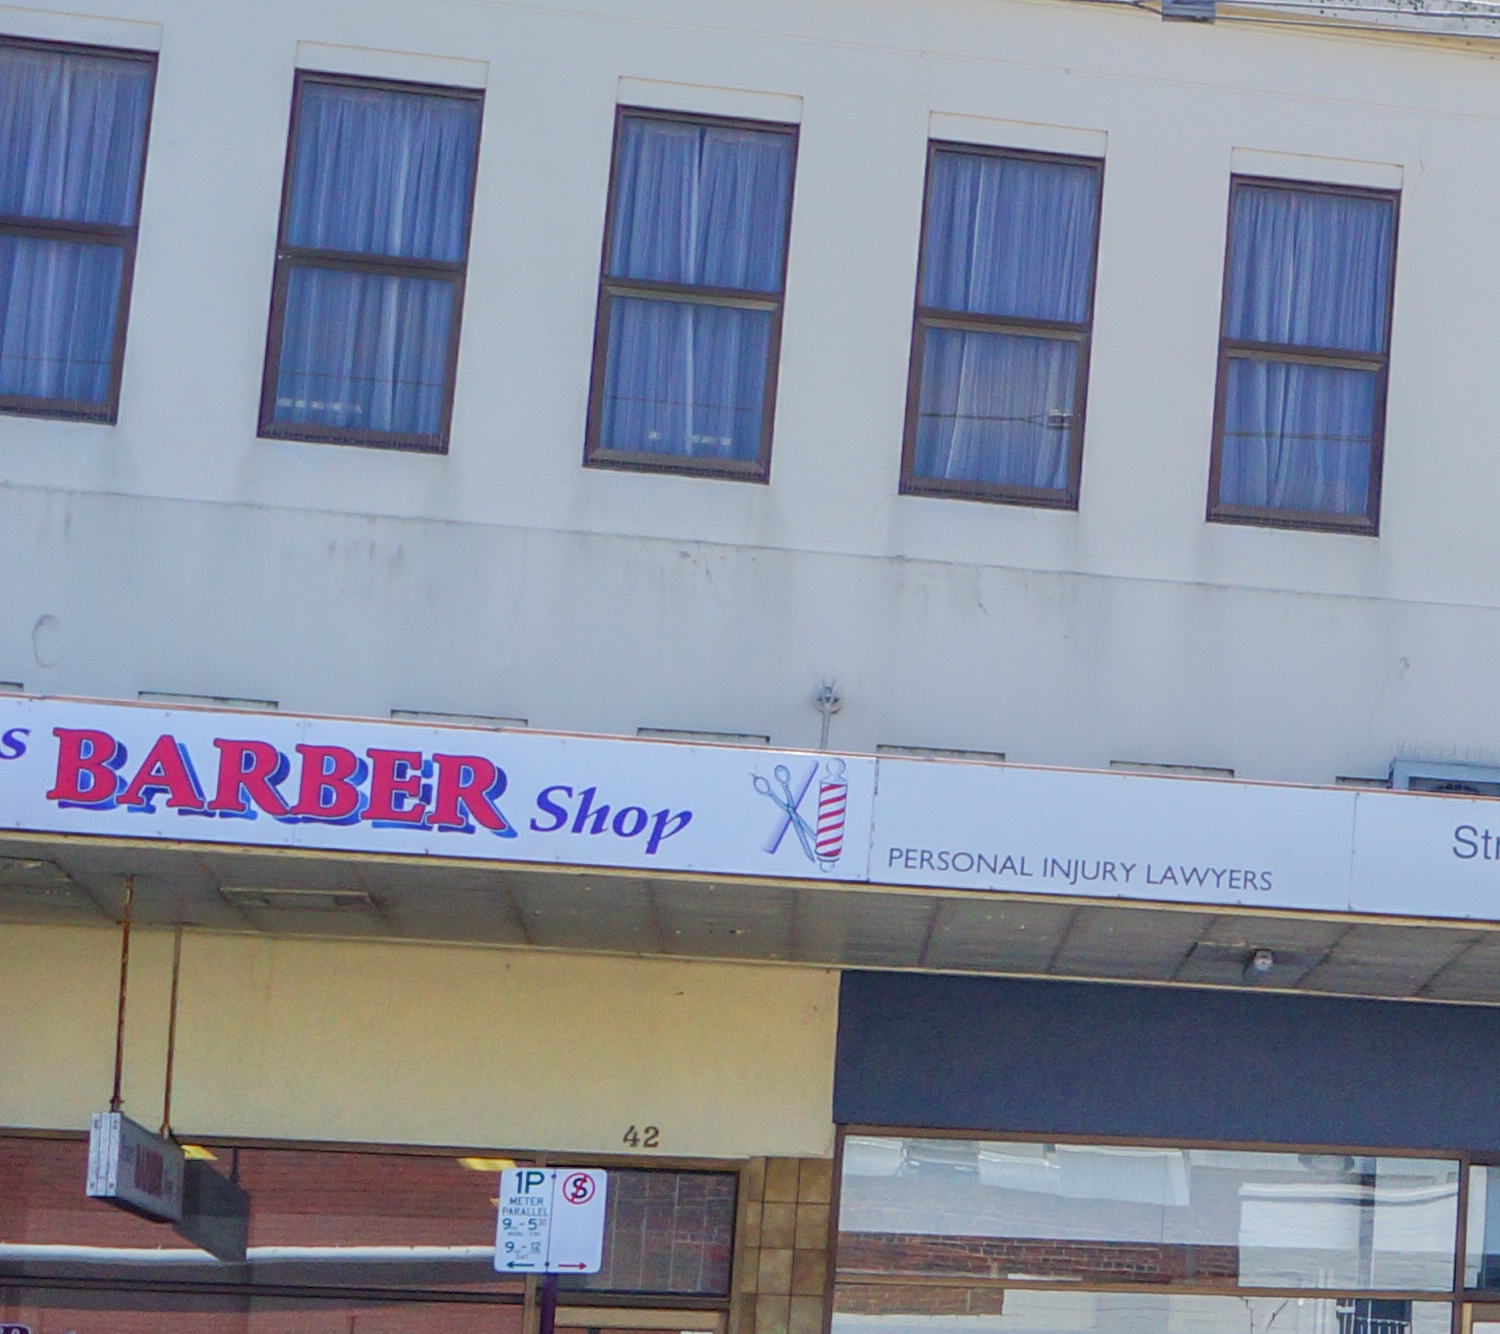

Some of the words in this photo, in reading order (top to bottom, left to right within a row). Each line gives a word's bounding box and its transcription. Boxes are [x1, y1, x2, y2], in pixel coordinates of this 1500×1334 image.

[47, 725, 518, 839] BARBER
[529, 783, 694, 855] Shop
[887, 846, 1034, 879] PERSONAL
[1042, 855, 1138, 886] INJURY
[1145, 863, 1273, 892] LAWYERS
[622, 1125, 661, 1150] 42
[515, 1170, 545, 1195] 1P
[502, 1207, 549, 1217] PARALLEL
[509, 1197, 544, 1207] METER
